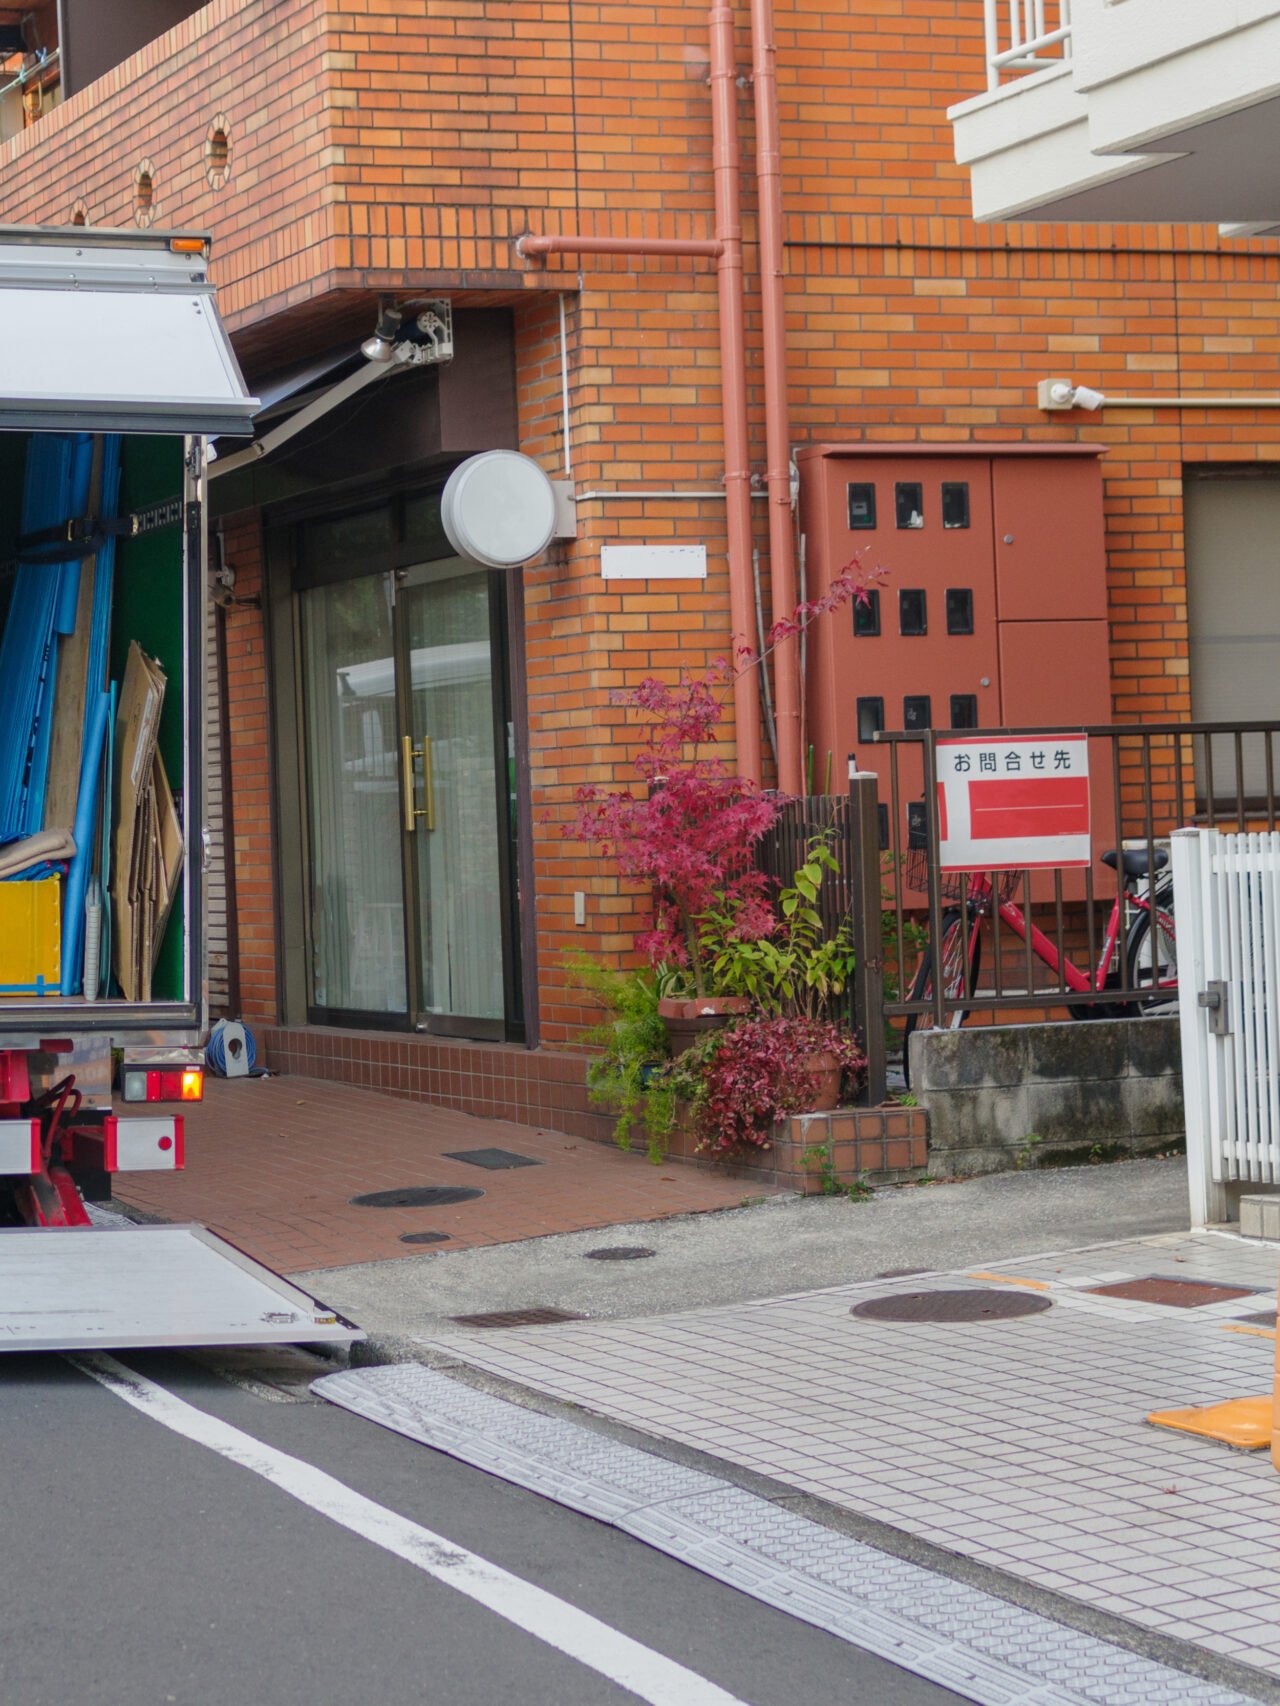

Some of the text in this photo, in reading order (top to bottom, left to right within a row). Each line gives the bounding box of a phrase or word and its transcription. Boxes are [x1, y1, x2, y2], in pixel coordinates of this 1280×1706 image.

[954, 750, 1071, 772] お問合せ先
